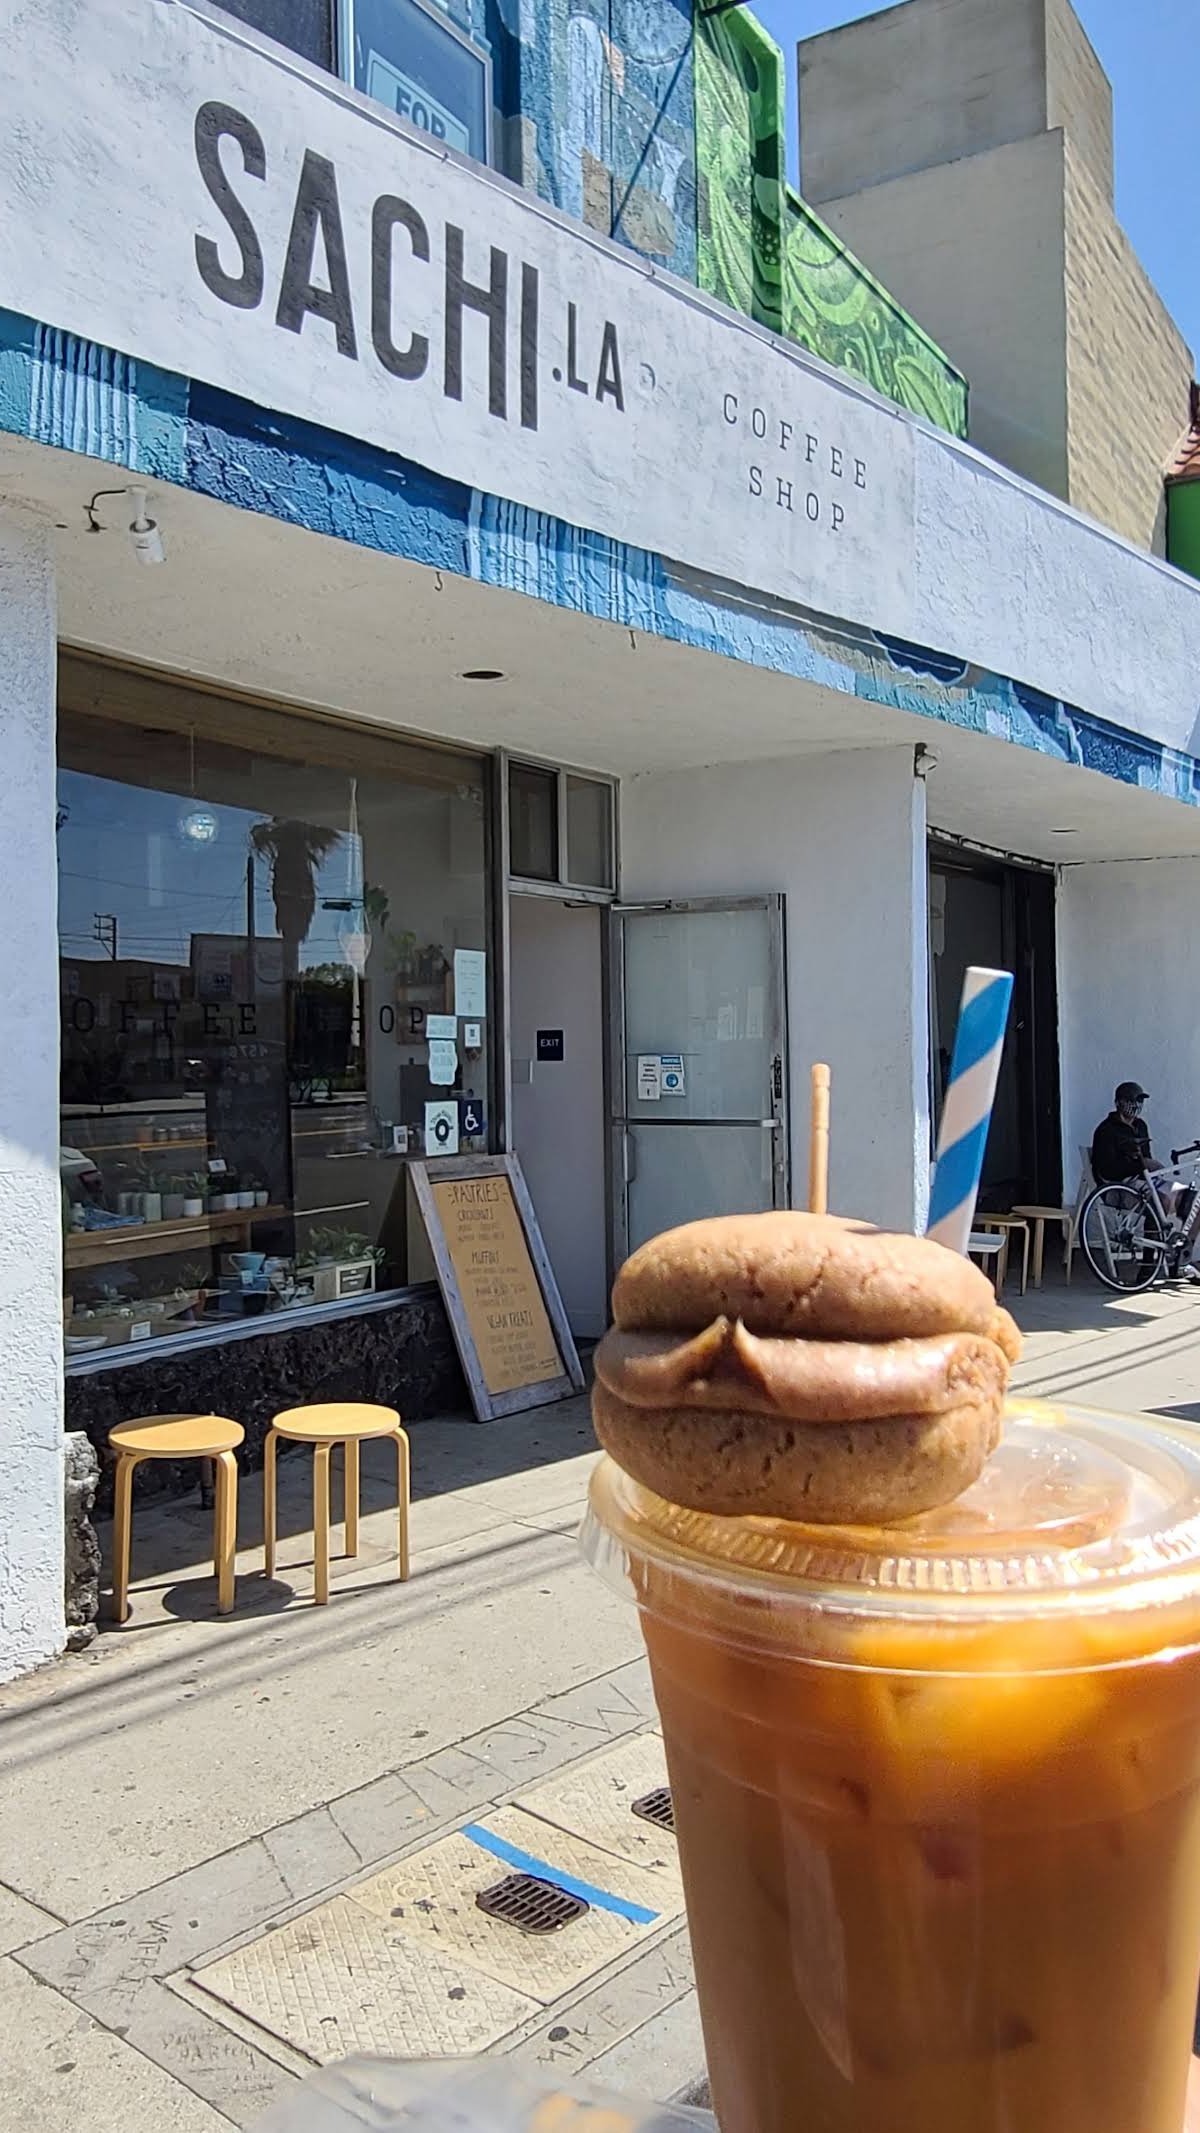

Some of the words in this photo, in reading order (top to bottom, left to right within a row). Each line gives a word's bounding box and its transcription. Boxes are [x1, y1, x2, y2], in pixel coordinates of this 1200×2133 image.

[723, 393, 866, 490] COFFEE
[749, 466, 845, 532] SHOP
[540, 1038, 560, 1047] EXIT
[453, 1182, 500, 1204] PASTRIES
